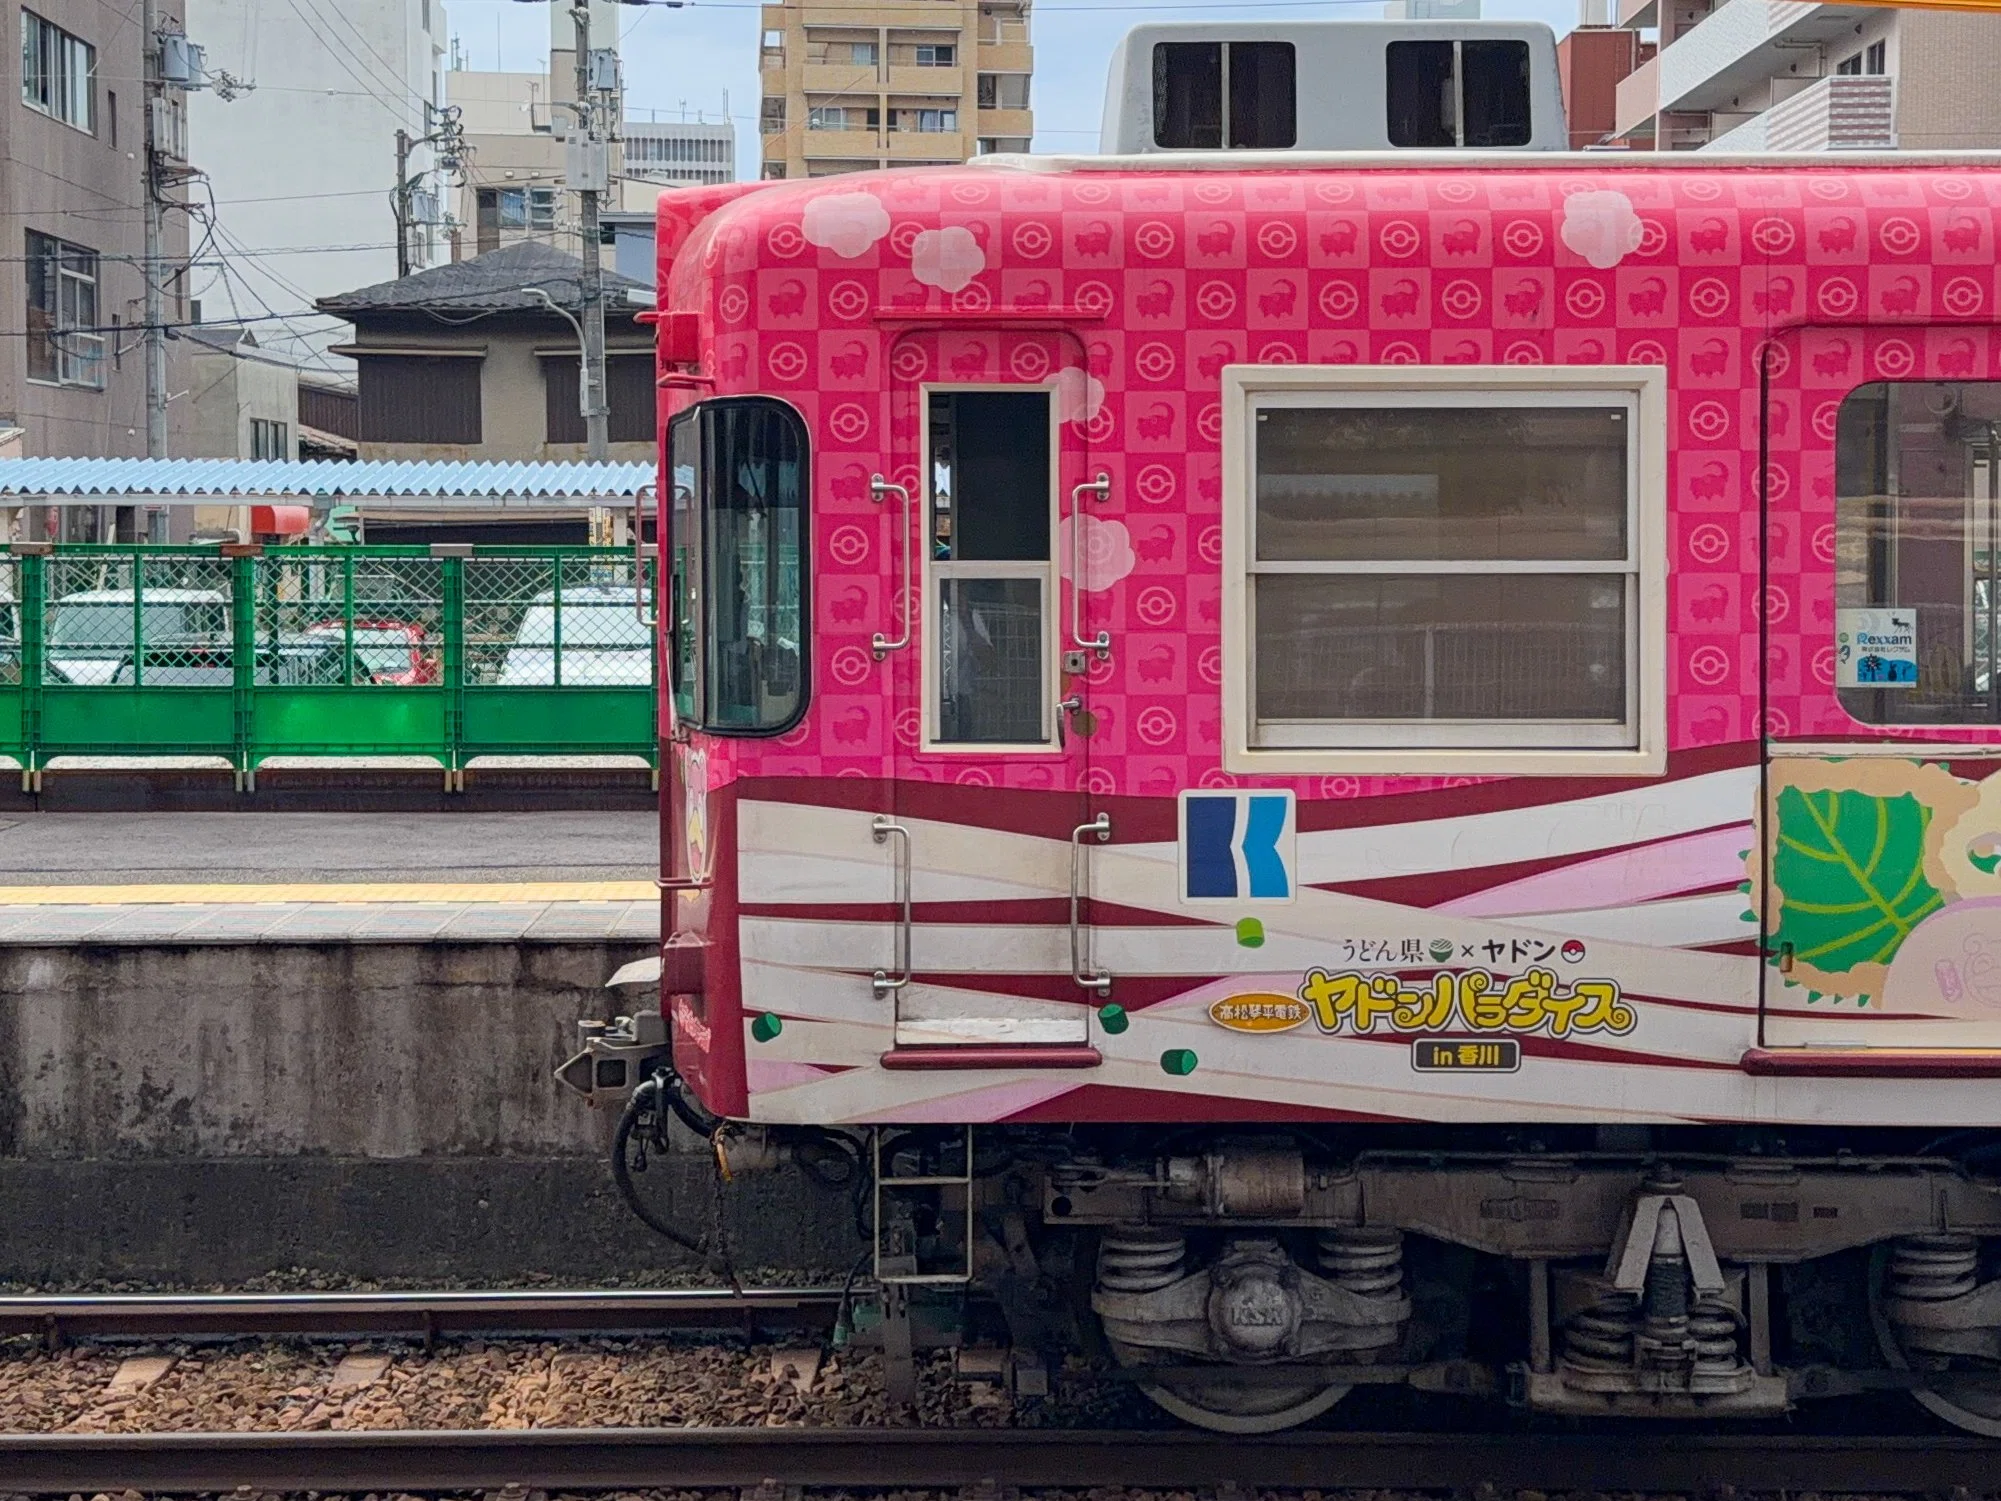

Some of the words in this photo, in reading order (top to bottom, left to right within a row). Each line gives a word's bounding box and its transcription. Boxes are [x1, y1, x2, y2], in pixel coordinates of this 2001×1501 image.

[1857, 632, 1912, 645] Rexxam
[1343, 938, 1425, 963] うどん県
[1482, 939, 1556, 963] ヤドン
[1220, 1003, 1302, 1020] 高松琴平電鉄
[1302, 968, 1634, 1035] ヤドンパラダイス
[1433, 1046, 1453, 1065] in
[1457, 1045, 1500, 1065] 香川
